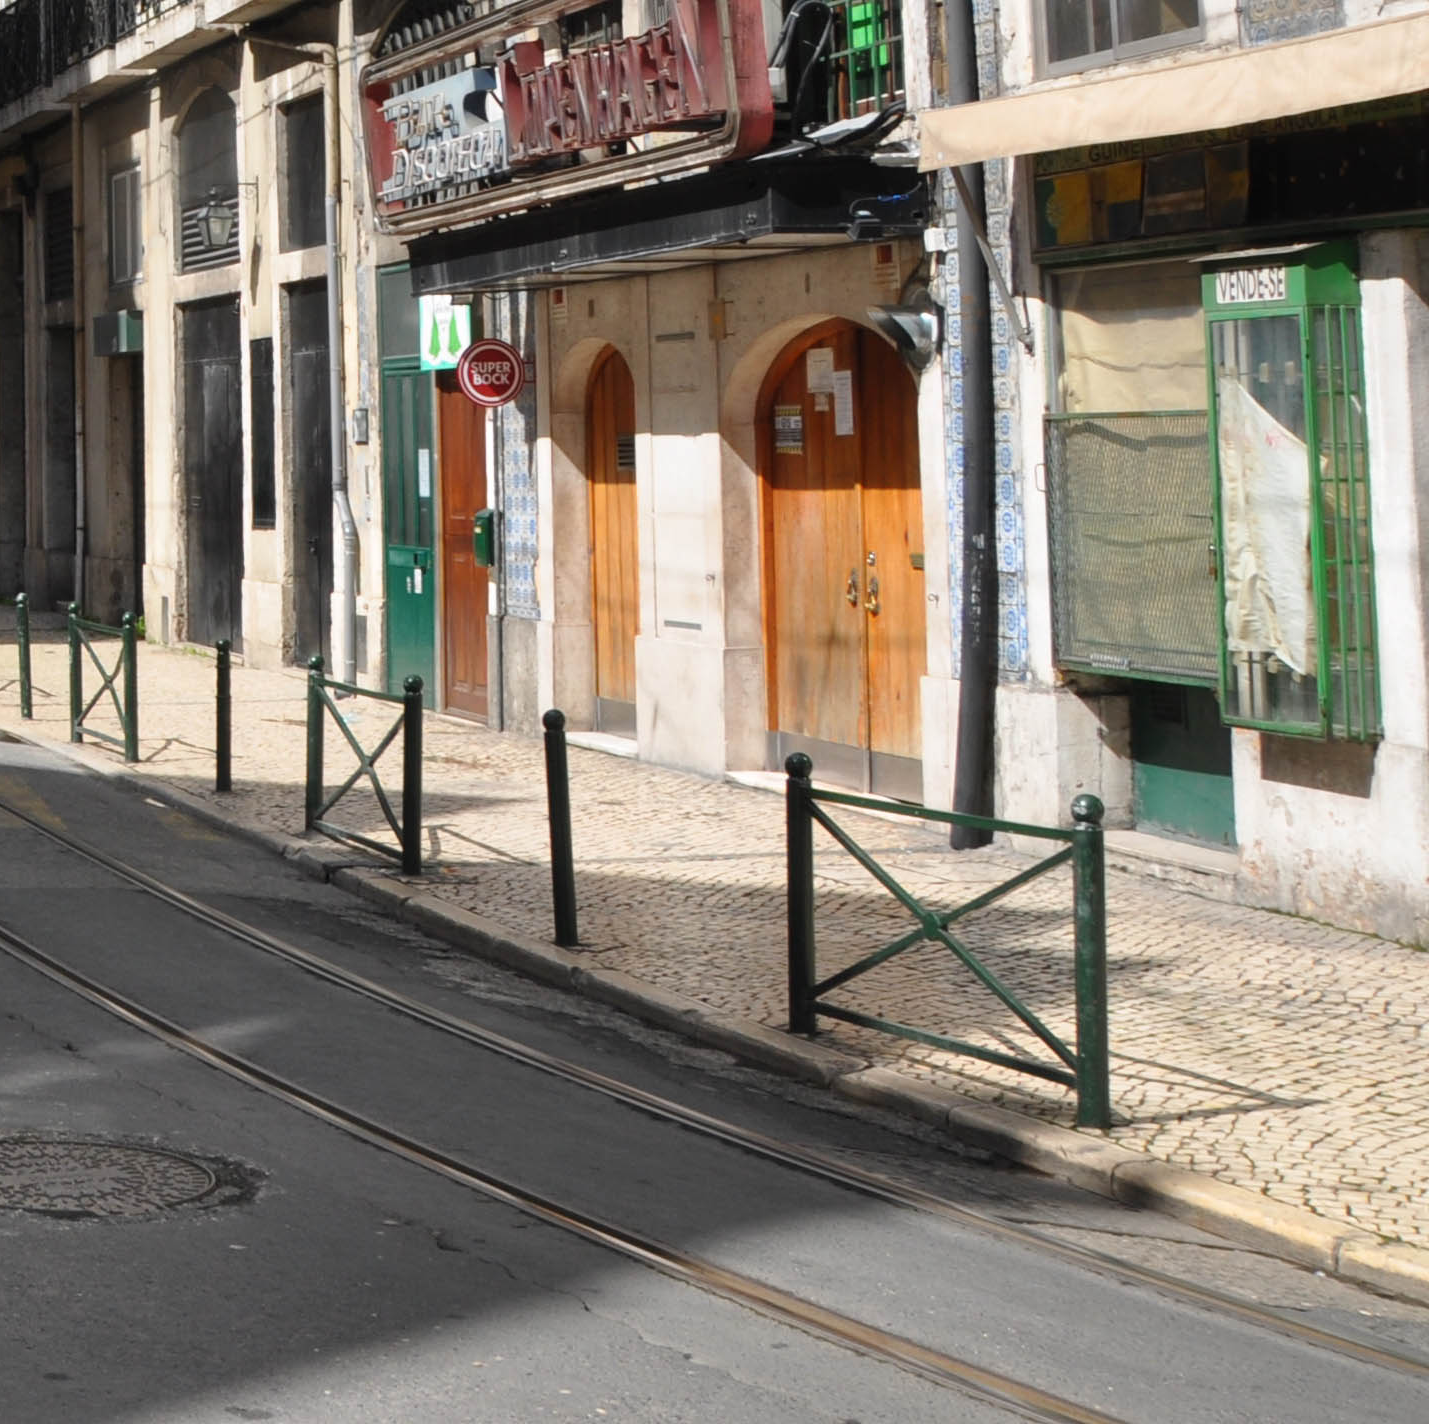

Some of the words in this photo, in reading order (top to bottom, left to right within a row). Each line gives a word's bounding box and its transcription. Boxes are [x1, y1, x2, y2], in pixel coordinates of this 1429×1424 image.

[1218, 265, 1284, 301] VENDE-SE
[470, 361, 511, 374] SUPER
[472, 372, 510, 386] BOCK
